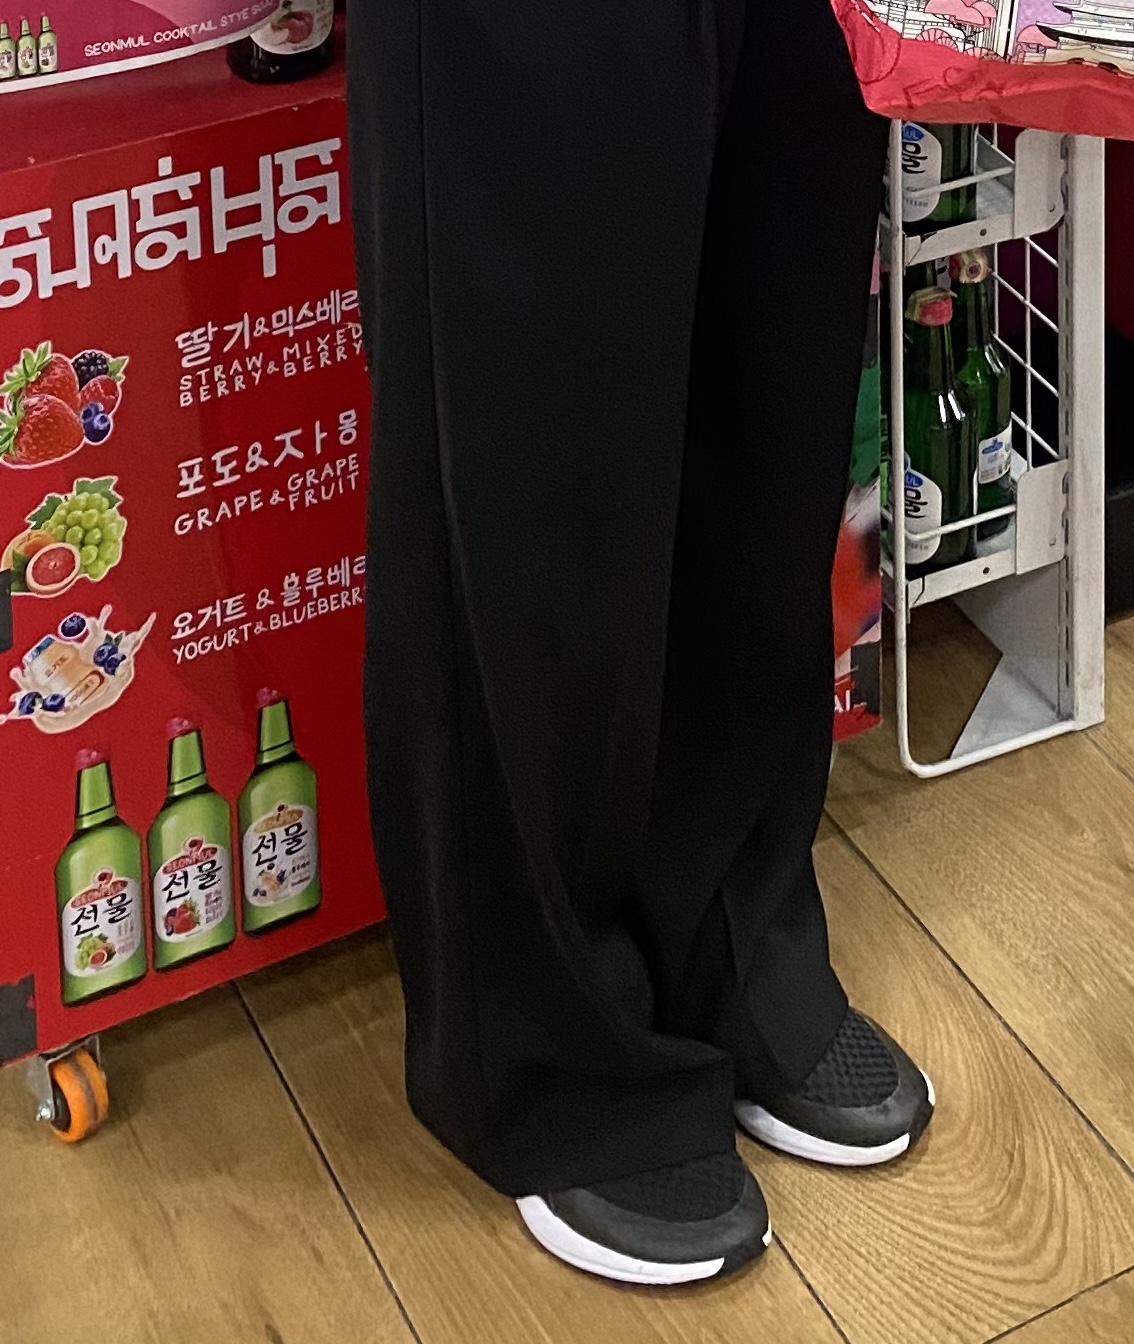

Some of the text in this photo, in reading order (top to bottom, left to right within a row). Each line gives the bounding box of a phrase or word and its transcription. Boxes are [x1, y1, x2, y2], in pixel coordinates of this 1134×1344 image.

[84, 34, 151, 58] SEONMUL
[179, 322, 364, 391] STRAW MIXED
[179, 339, 364, 408] BERRY & BERRY
[174, 452, 360, 536] GRAPE & GRAPE
[288, 470, 360, 512] FRUIT
[170, 592, 248, 641] 요거트
[255, 587, 275, 610] &
[172, 586, 363, 665] YOGURT & BLUEBERR
